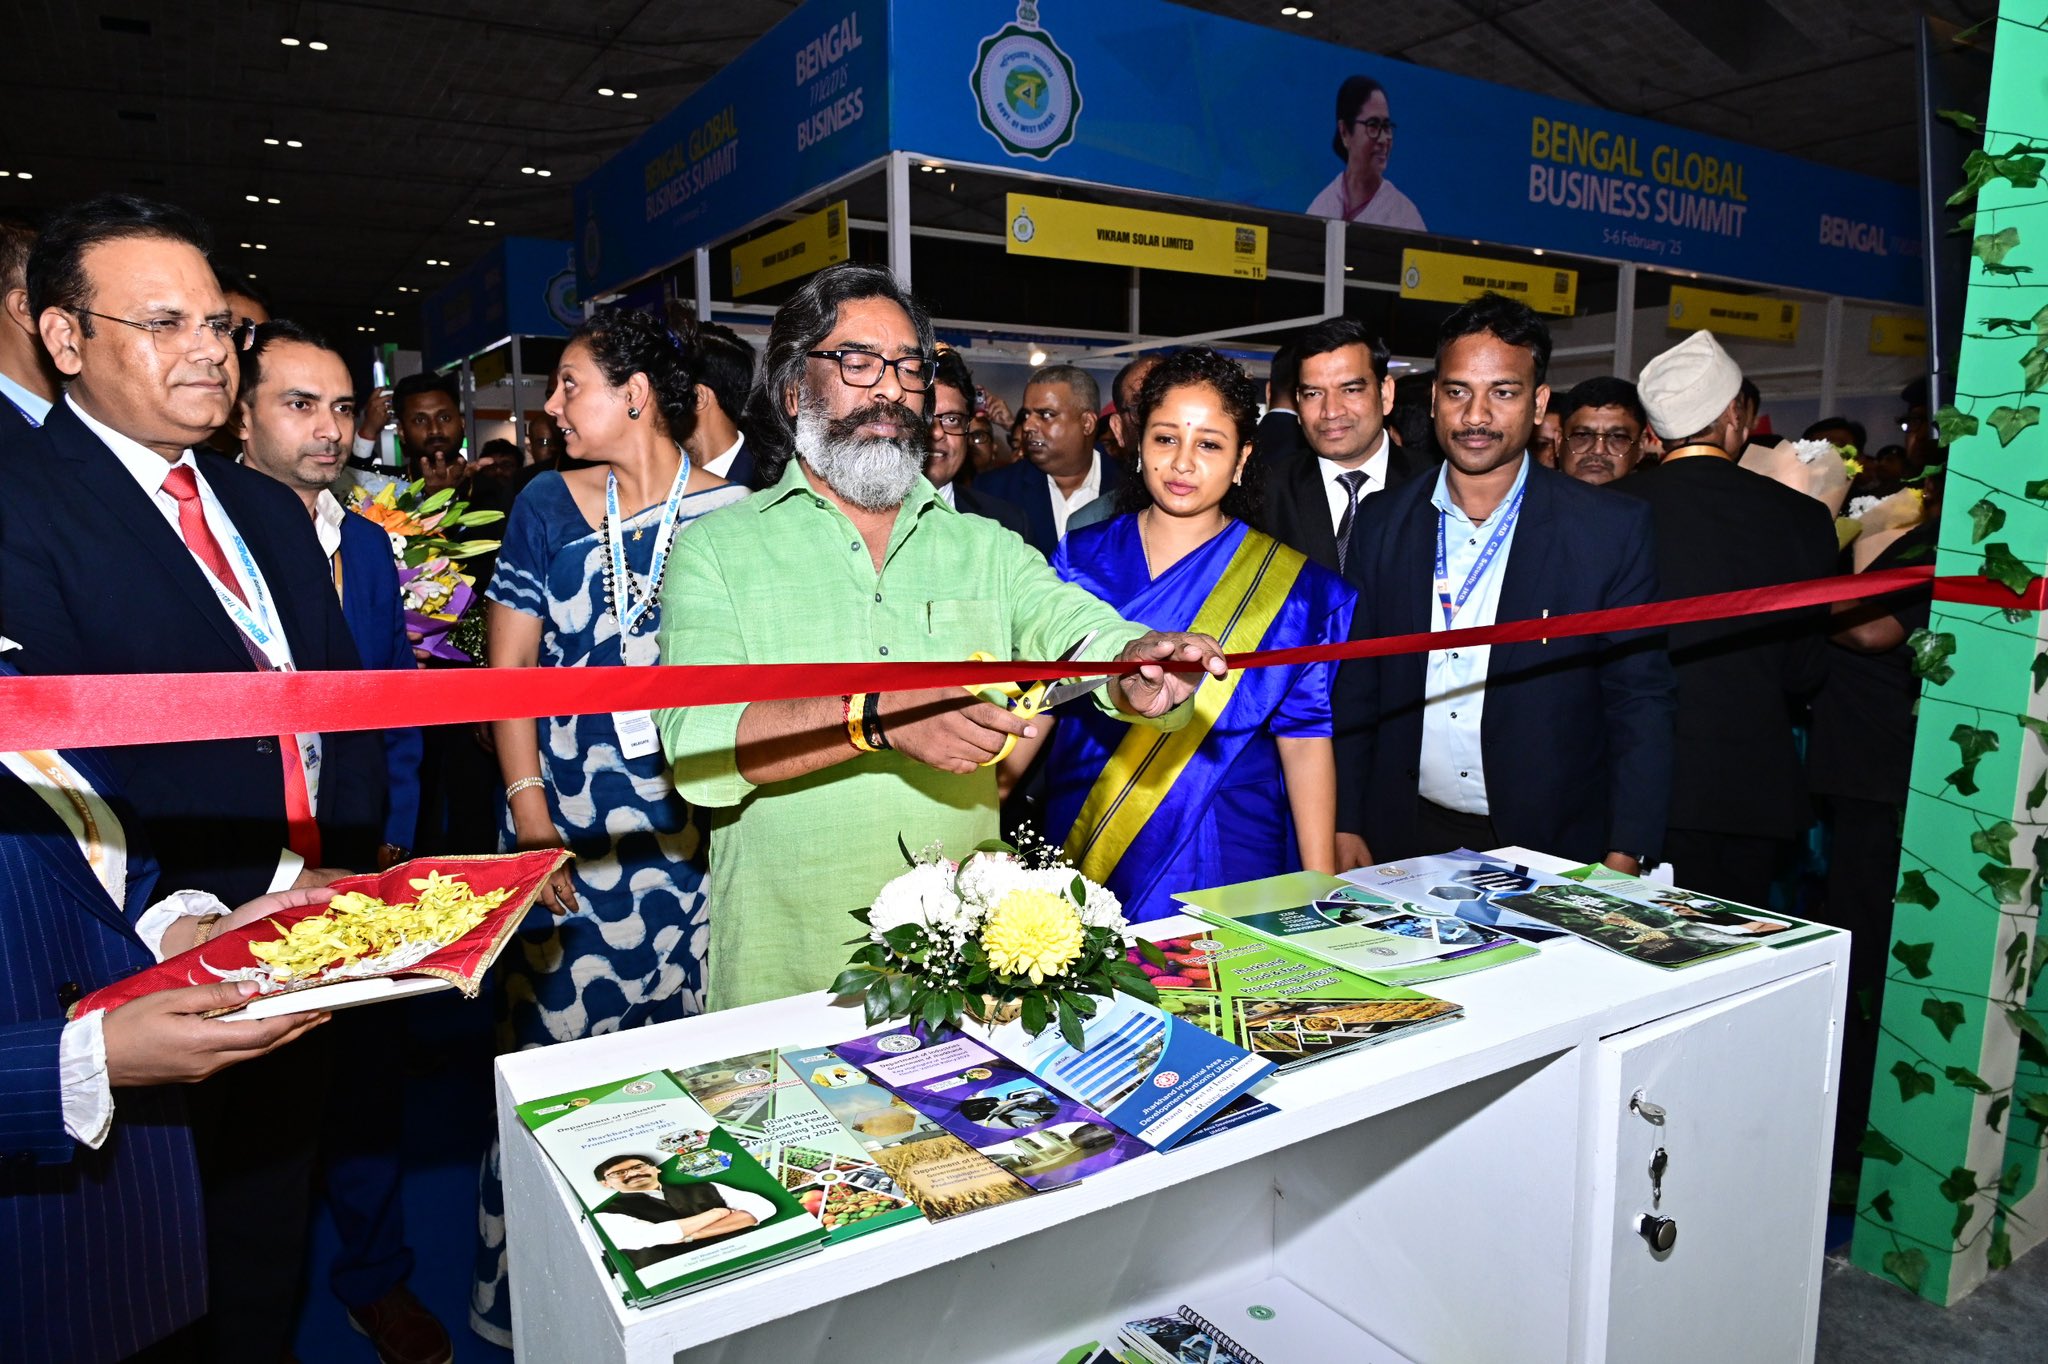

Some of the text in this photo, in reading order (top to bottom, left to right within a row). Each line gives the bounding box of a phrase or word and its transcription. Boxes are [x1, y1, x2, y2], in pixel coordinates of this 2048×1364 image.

[796, 11, 862, 87] BENGAL
[689, 104, 738, 162] GLOBAL
[797, 87, 863, 152] BUSINESS
[1020, 125, 1037, 133] WEST
[1531, 116, 1748, 201] BENGAL GLOBAL
[646, 170, 691, 223] BUSINESS
[692, 139, 738, 195] SUMMIT
[1529, 164, 1748, 238] BUSINESS SUMMIT
[1097, 229, 1194, 251] VIKRAM SOLAR LIMITED
[1603, 228, 1620, 244] 5-6
[1622, 230, 1666, 256] February
[1819, 214, 1888, 257] BENGAL
[233, 535, 257, 577] BUSINESS
[613, 542, 622, 575] BUSINESS
[651, 552, 664, 584] BUSINESS
[233, 607, 270, 644] BENGAL
[1139, 1092, 1186, 1127] Development
[1185, 1071, 1216, 1095] Authority
[1142, 1058, 1223, 1116] Jharkhand Industrial Area
[557, 1116, 610, 1133] Department
[623, 1103, 667, 1117] Industries
[587, 1119, 667, 1143] Jharkhand MSME
[766, 1109, 818, 1126] Jharkhand
[766, 1123, 791, 1135] Food
[804, 1114, 829, 1124] Feed
[1145, 1108, 1183, 1137] Jharkhand
[581, 1135, 628, 1150] Promotion
[629, 1127, 655, 1138] Policy
[751, 1127, 809, 1146] Processing
[780, 1127, 839, 1146] Policy 2024
[913, 1161, 960, 1176] Department
[927, 1166, 966, 1178] Government
